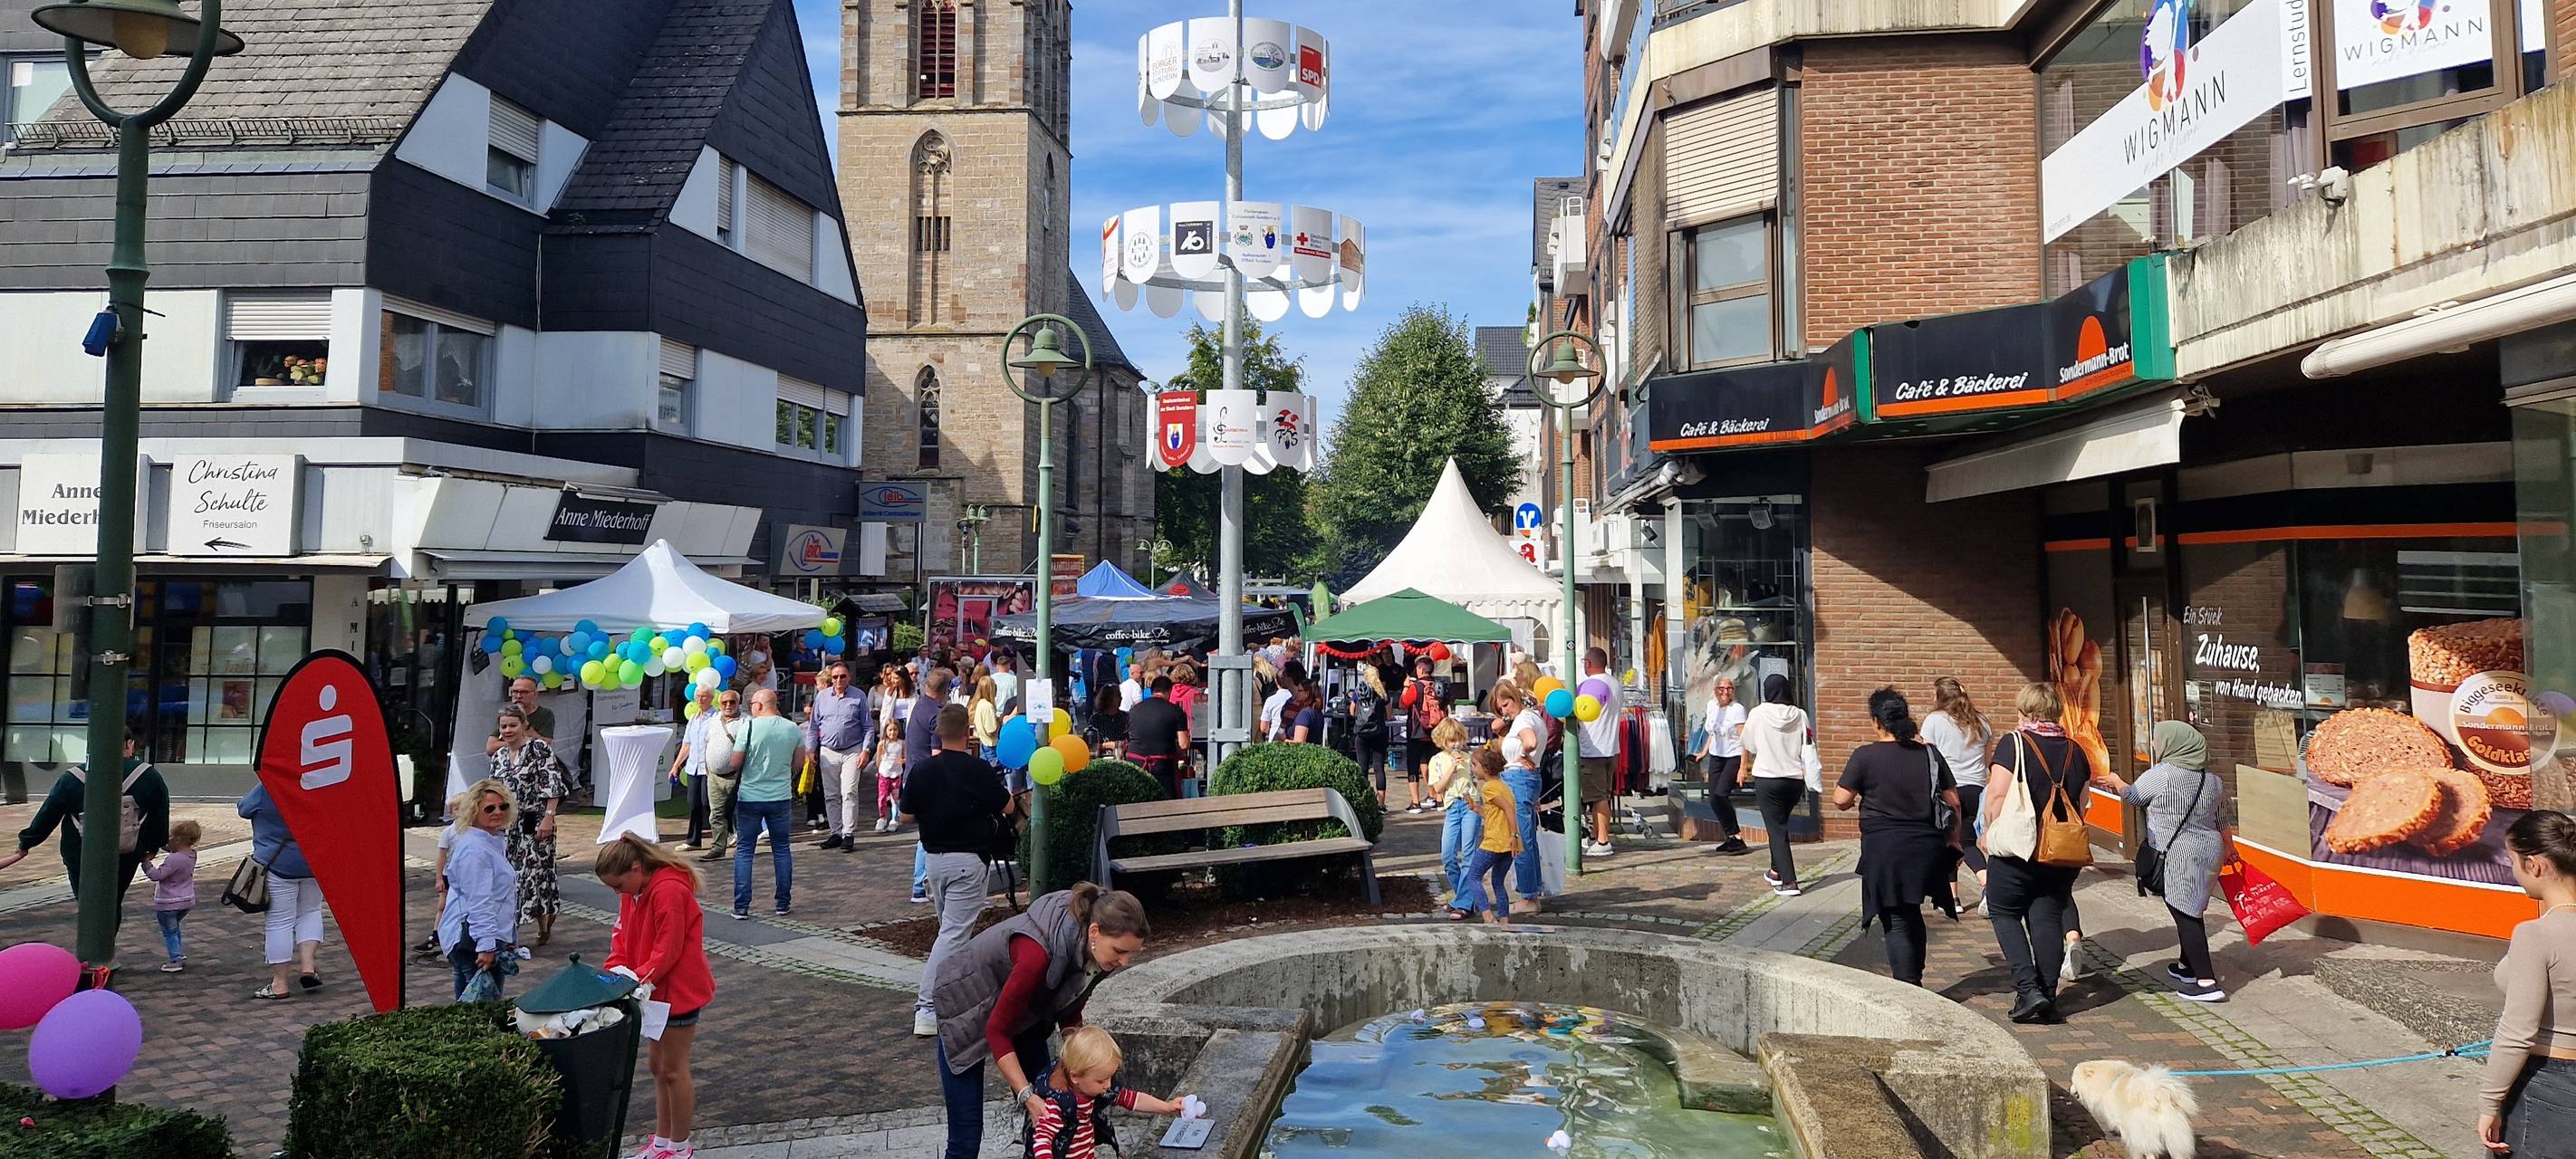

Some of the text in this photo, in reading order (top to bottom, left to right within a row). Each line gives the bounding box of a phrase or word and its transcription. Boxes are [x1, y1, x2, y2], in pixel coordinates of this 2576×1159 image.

[2285, 0, 2307, 92] Lernstud
[2344, 16, 2483, 61] WIGMANN
[1302, 68, 1320, 84] SPD
[2124, 70, 2225, 165] WIGMANN
[2059, 341, 2129, 384] Sondermann-Brot
[1896, 372, 2029, 400] Café & Bäckerei
[1680, 417, 1770, 436] Café & Bäckerei
[187, 459, 279, 484] Christina
[52, 484, 102, 498] Anne
[194, 488, 269, 514] Schulte
[22, 508, 100, 525] Miederh
[203, 519, 258, 529] Friseursalon
[554, 507, 652, 531] Anne Miederhoff
[2183, 605, 2223, 626] Ein Stück
[1105, 629, 1151, 640] coffee-bike
[2196, 633, 2261, 674] Zuhause,
[2215, 680, 2231, 695] von
[2232, 678, 2257, 700] Hand
[2256, 681, 2304, 706] gebacken.
